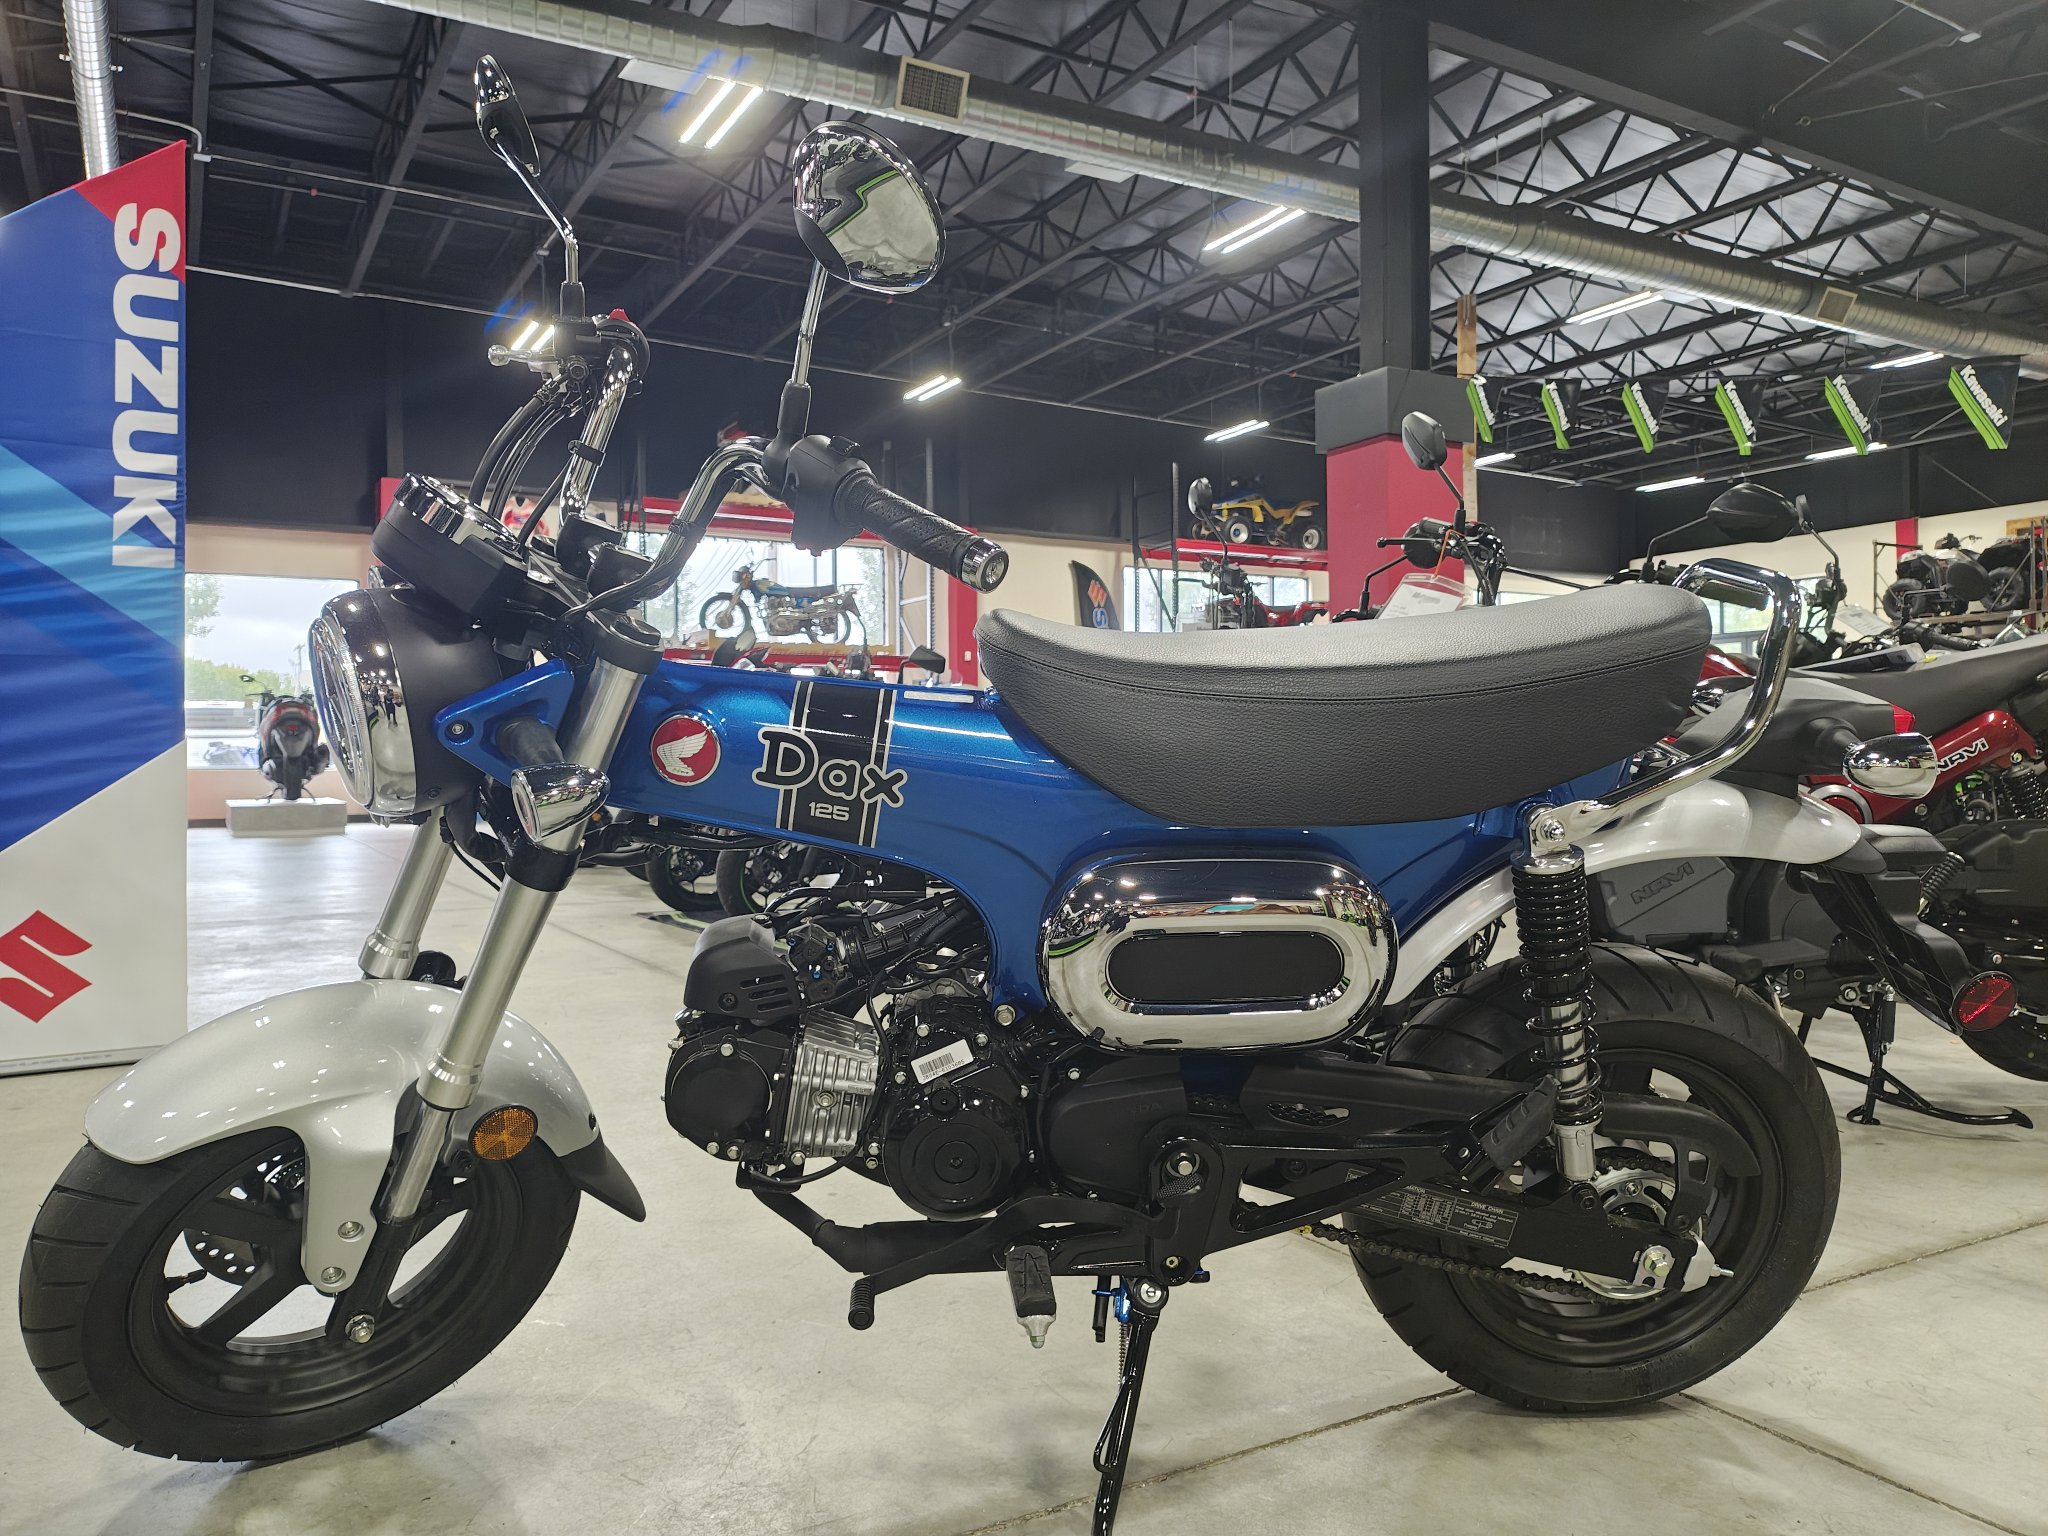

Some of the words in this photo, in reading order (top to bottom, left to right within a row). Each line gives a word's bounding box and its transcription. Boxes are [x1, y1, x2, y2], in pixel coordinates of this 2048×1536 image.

[111, 202, 181, 569] SUZUKI
[1832, 374, 1871, 433] Kawasaki
[1960, 364, 2008, 427] Kawasaki
[752, 726, 908, 808] Dax
[808, 801, 850, 821] 125
